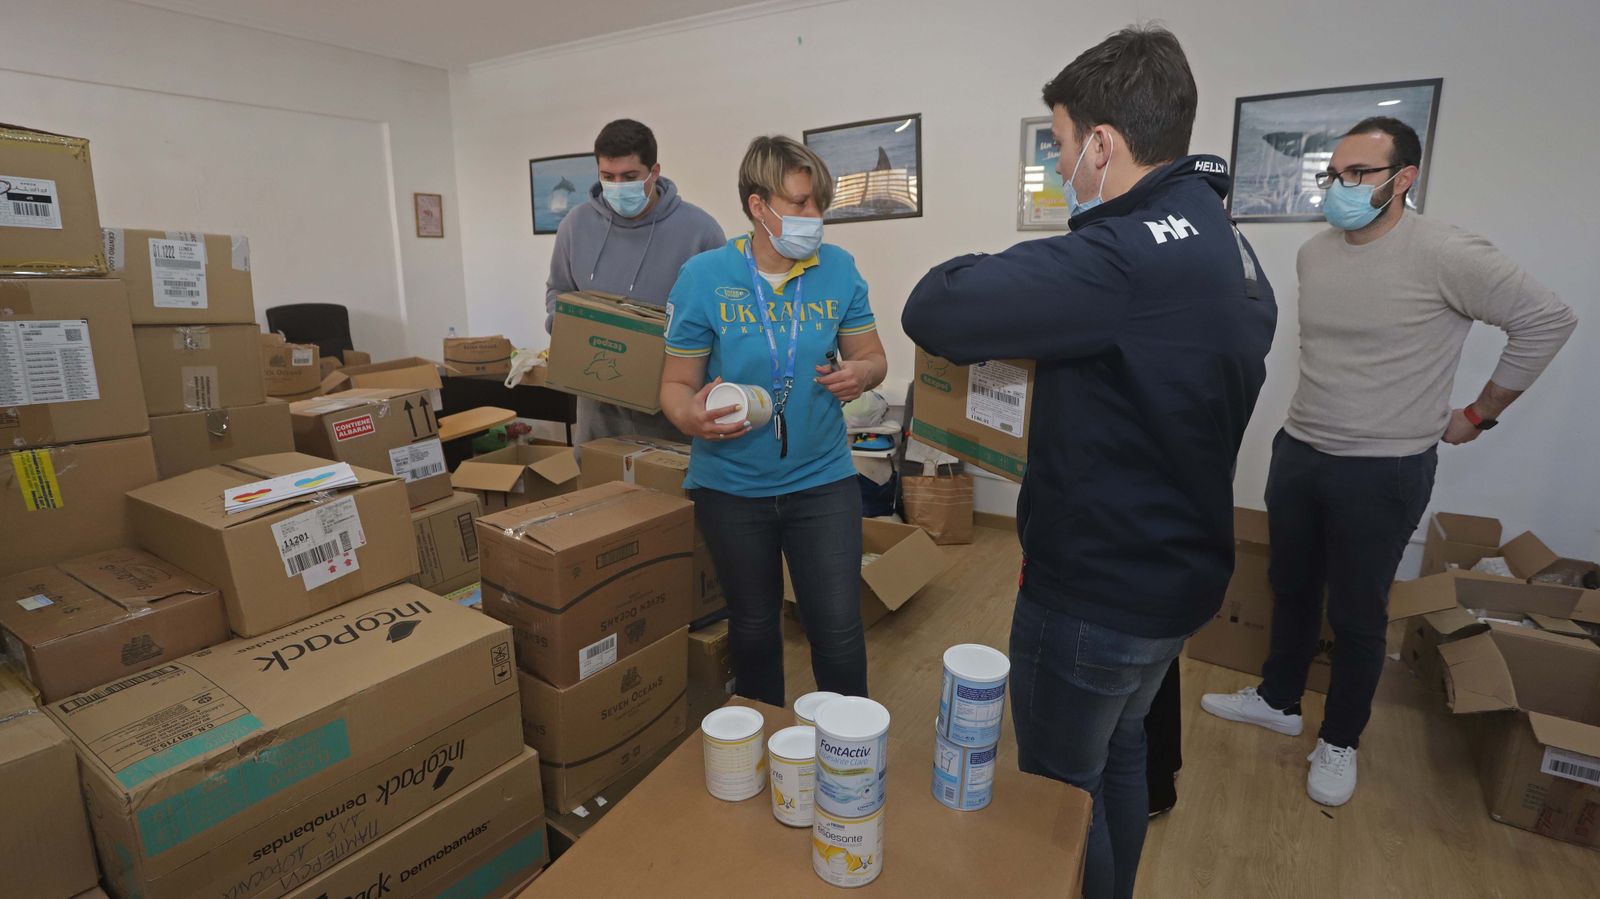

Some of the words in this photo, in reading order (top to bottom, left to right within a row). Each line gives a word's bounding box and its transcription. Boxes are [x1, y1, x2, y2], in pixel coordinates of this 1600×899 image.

[1194, 160, 1226, 174] HELLY
[1143, 212, 1200, 244] HH
[719, 299, 840, 324] UKRAINE
[335, 417, 371, 432] CONTIENE
[338, 424, 373, 438] ALBARAN
[283, 532, 310, 549] 11201
[631, 675, 664, 702] OCEANS
[820, 738, 872, 758] FontActiv
[251, 792, 368, 863] Dermobandas
[400, 821, 488, 884] Dermobandas
